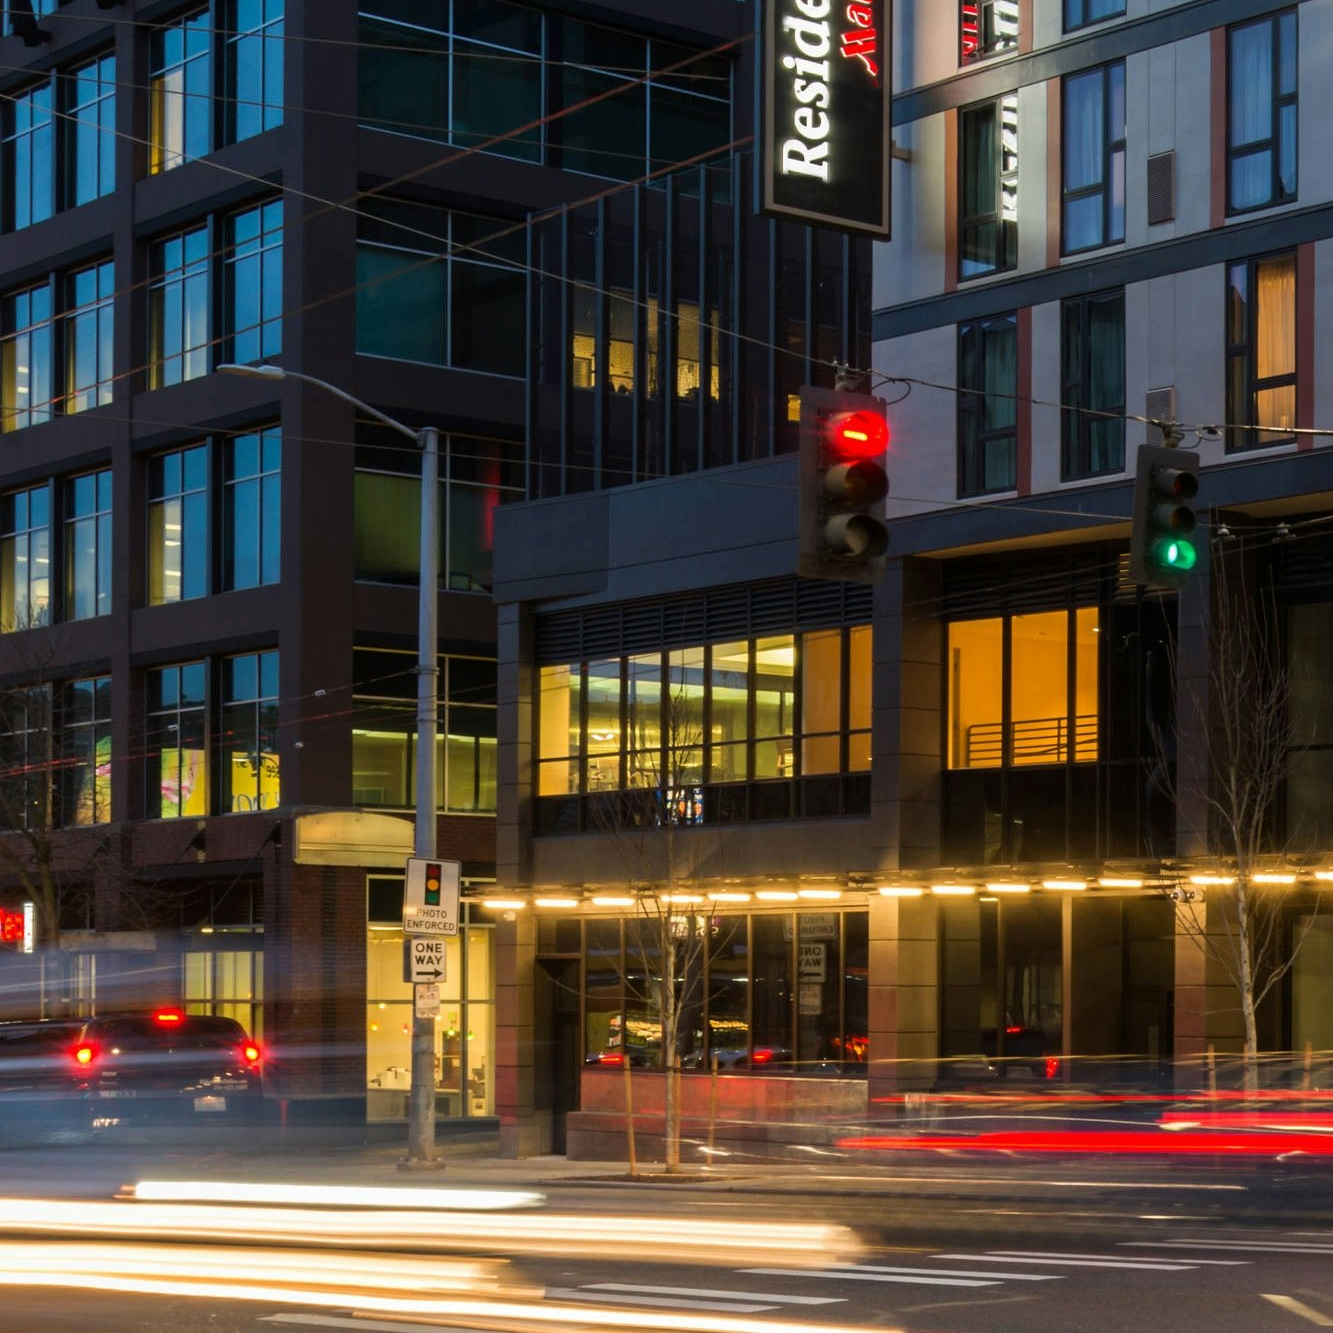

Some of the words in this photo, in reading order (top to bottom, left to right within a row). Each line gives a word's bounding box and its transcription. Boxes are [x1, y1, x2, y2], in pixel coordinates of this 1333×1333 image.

[416, 908, 448, 919] PHOTO
[407, 920, 455, 931] ENFORCED
[415, 943, 443, 953] ONE
[415, 955, 443, 965] WAY
